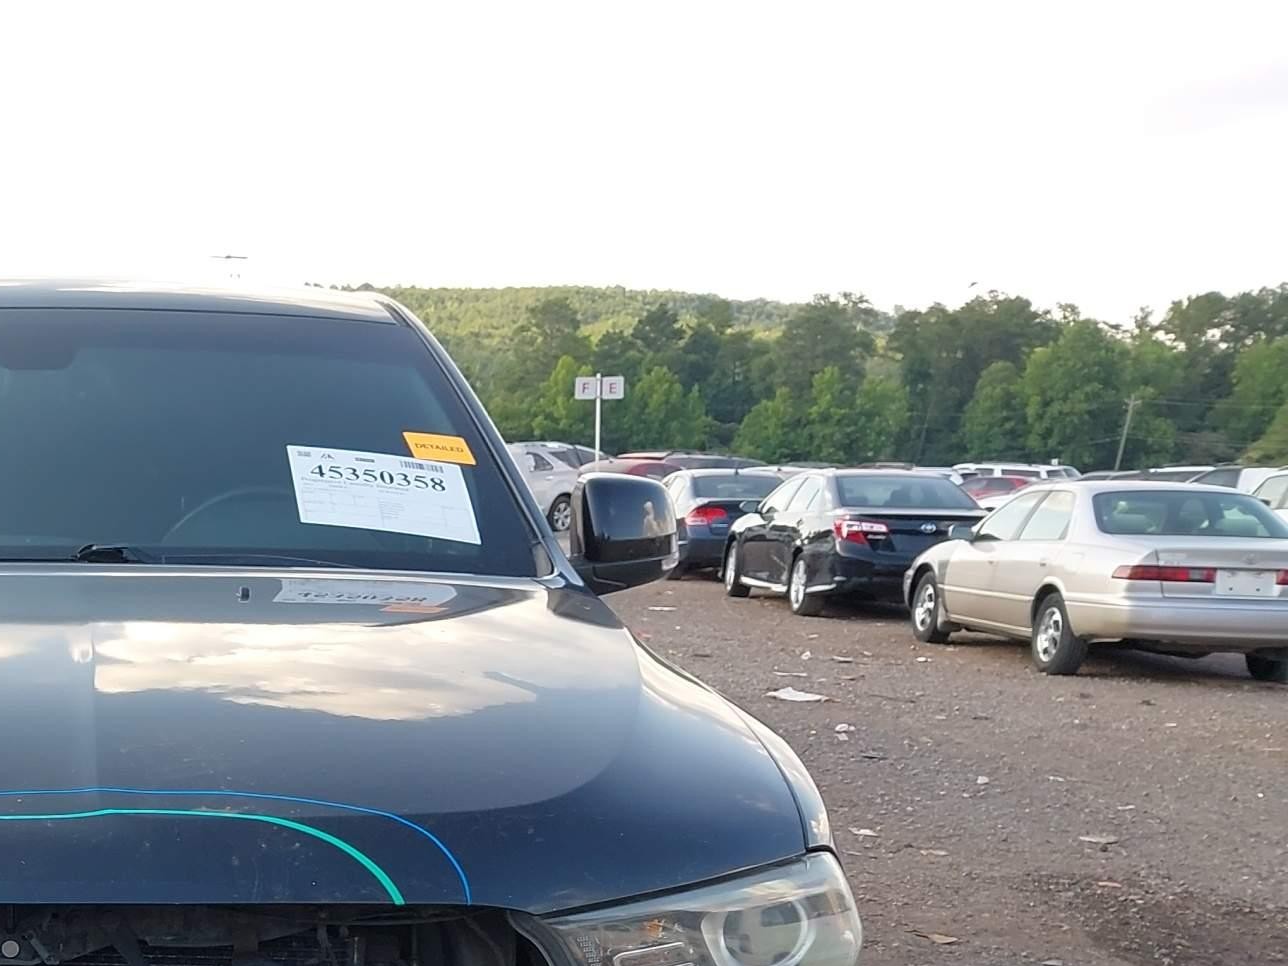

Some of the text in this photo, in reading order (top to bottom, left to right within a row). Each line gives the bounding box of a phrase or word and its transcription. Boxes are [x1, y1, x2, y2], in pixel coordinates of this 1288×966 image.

[582, 382, 590, 394] F
[609, 382, 617, 394] E
[310, 464, 447, 493] 45350358
